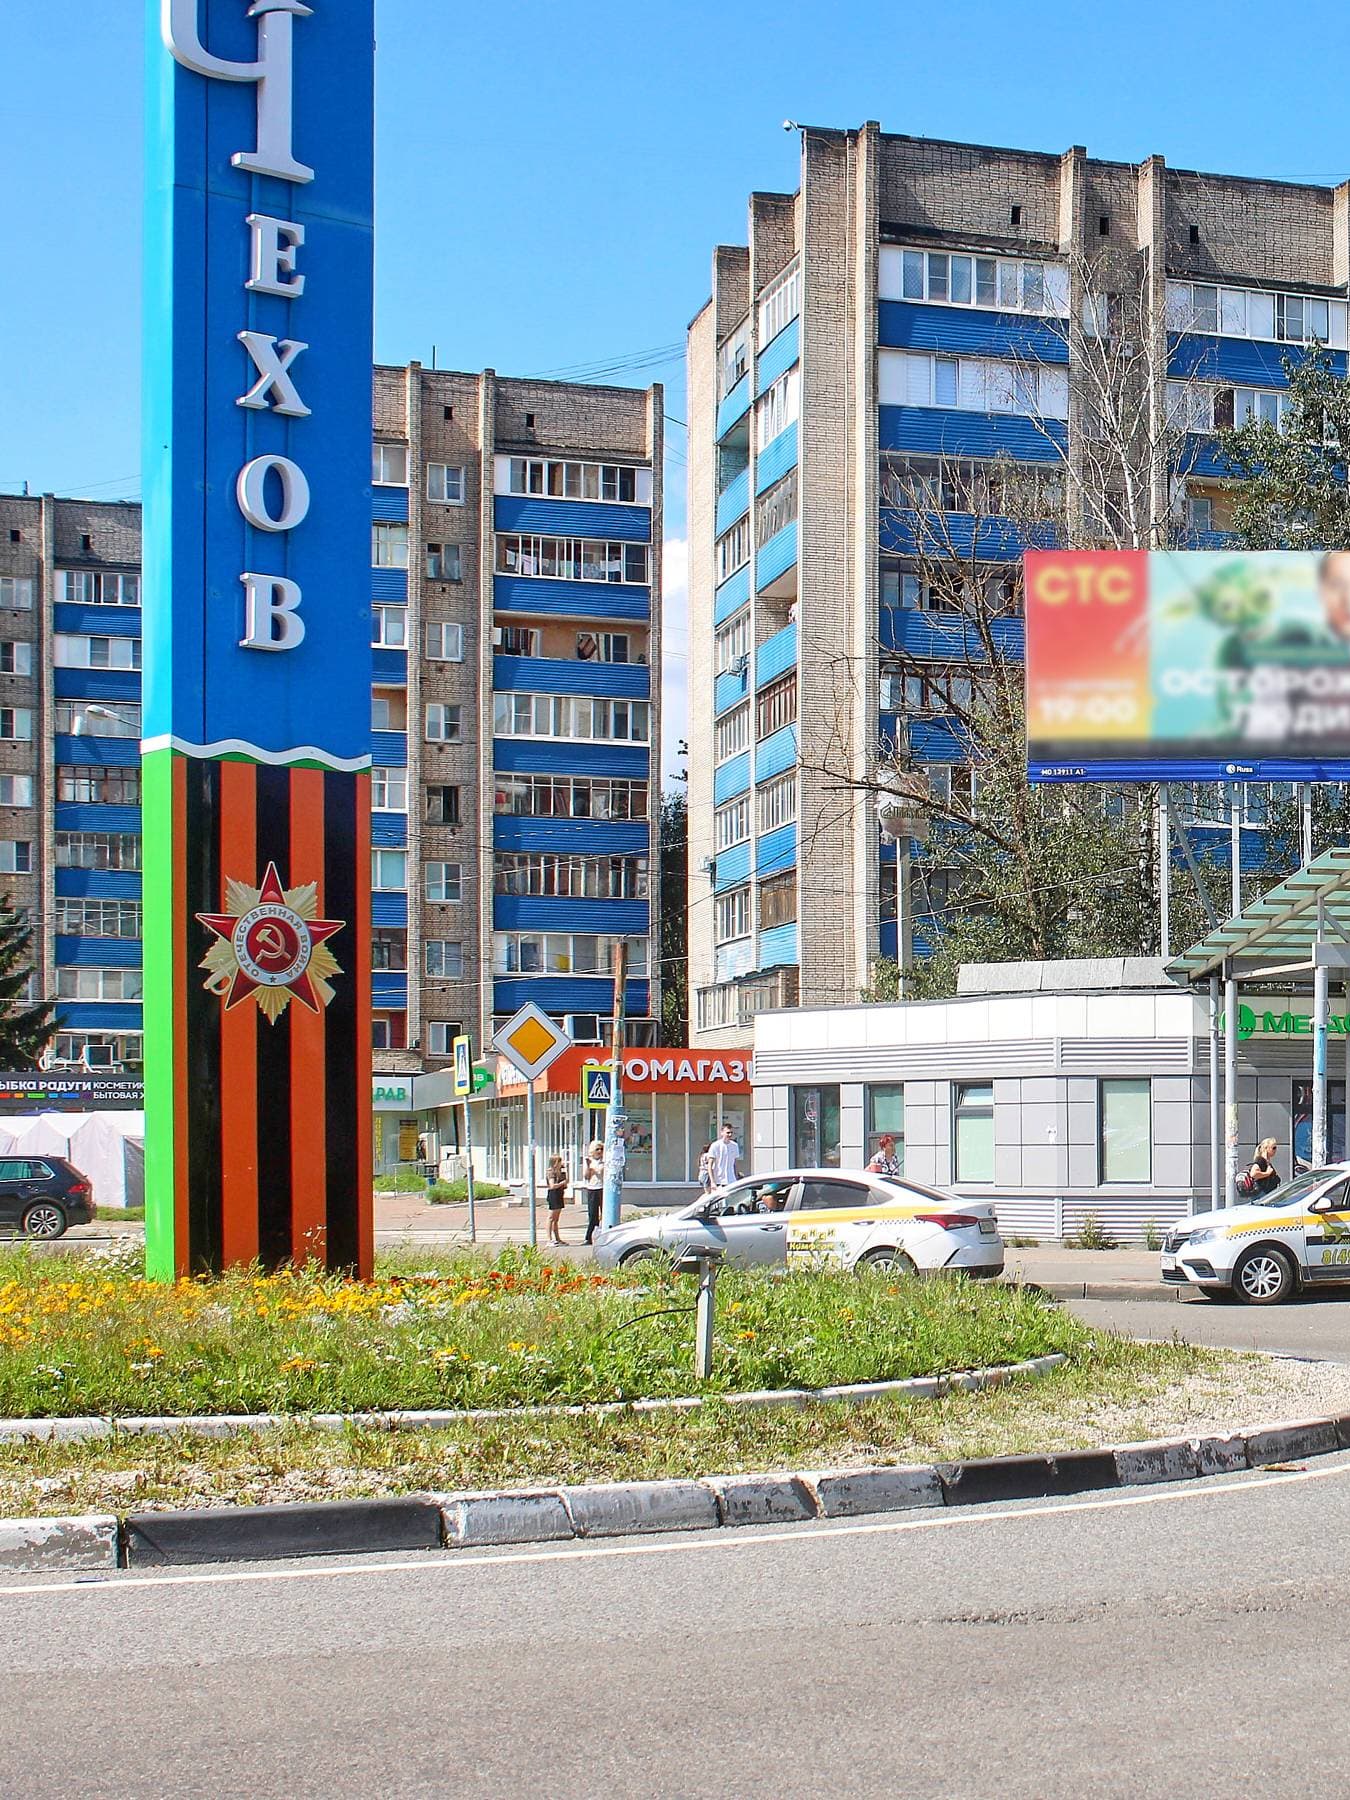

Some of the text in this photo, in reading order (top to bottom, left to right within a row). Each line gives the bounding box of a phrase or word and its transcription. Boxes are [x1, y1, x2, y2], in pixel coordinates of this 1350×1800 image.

[160, 0, 315, 652] ЧЕХОВ
[1236, 765, 1254, 773] Russ
[236, 906, 303, 978] ОТЕЧЕСТВЕННАЯ
[584, 1058, 753, 1083] ОМАГАЗ
[93, 1091, 139, 1099] БЫТОВАЯ
